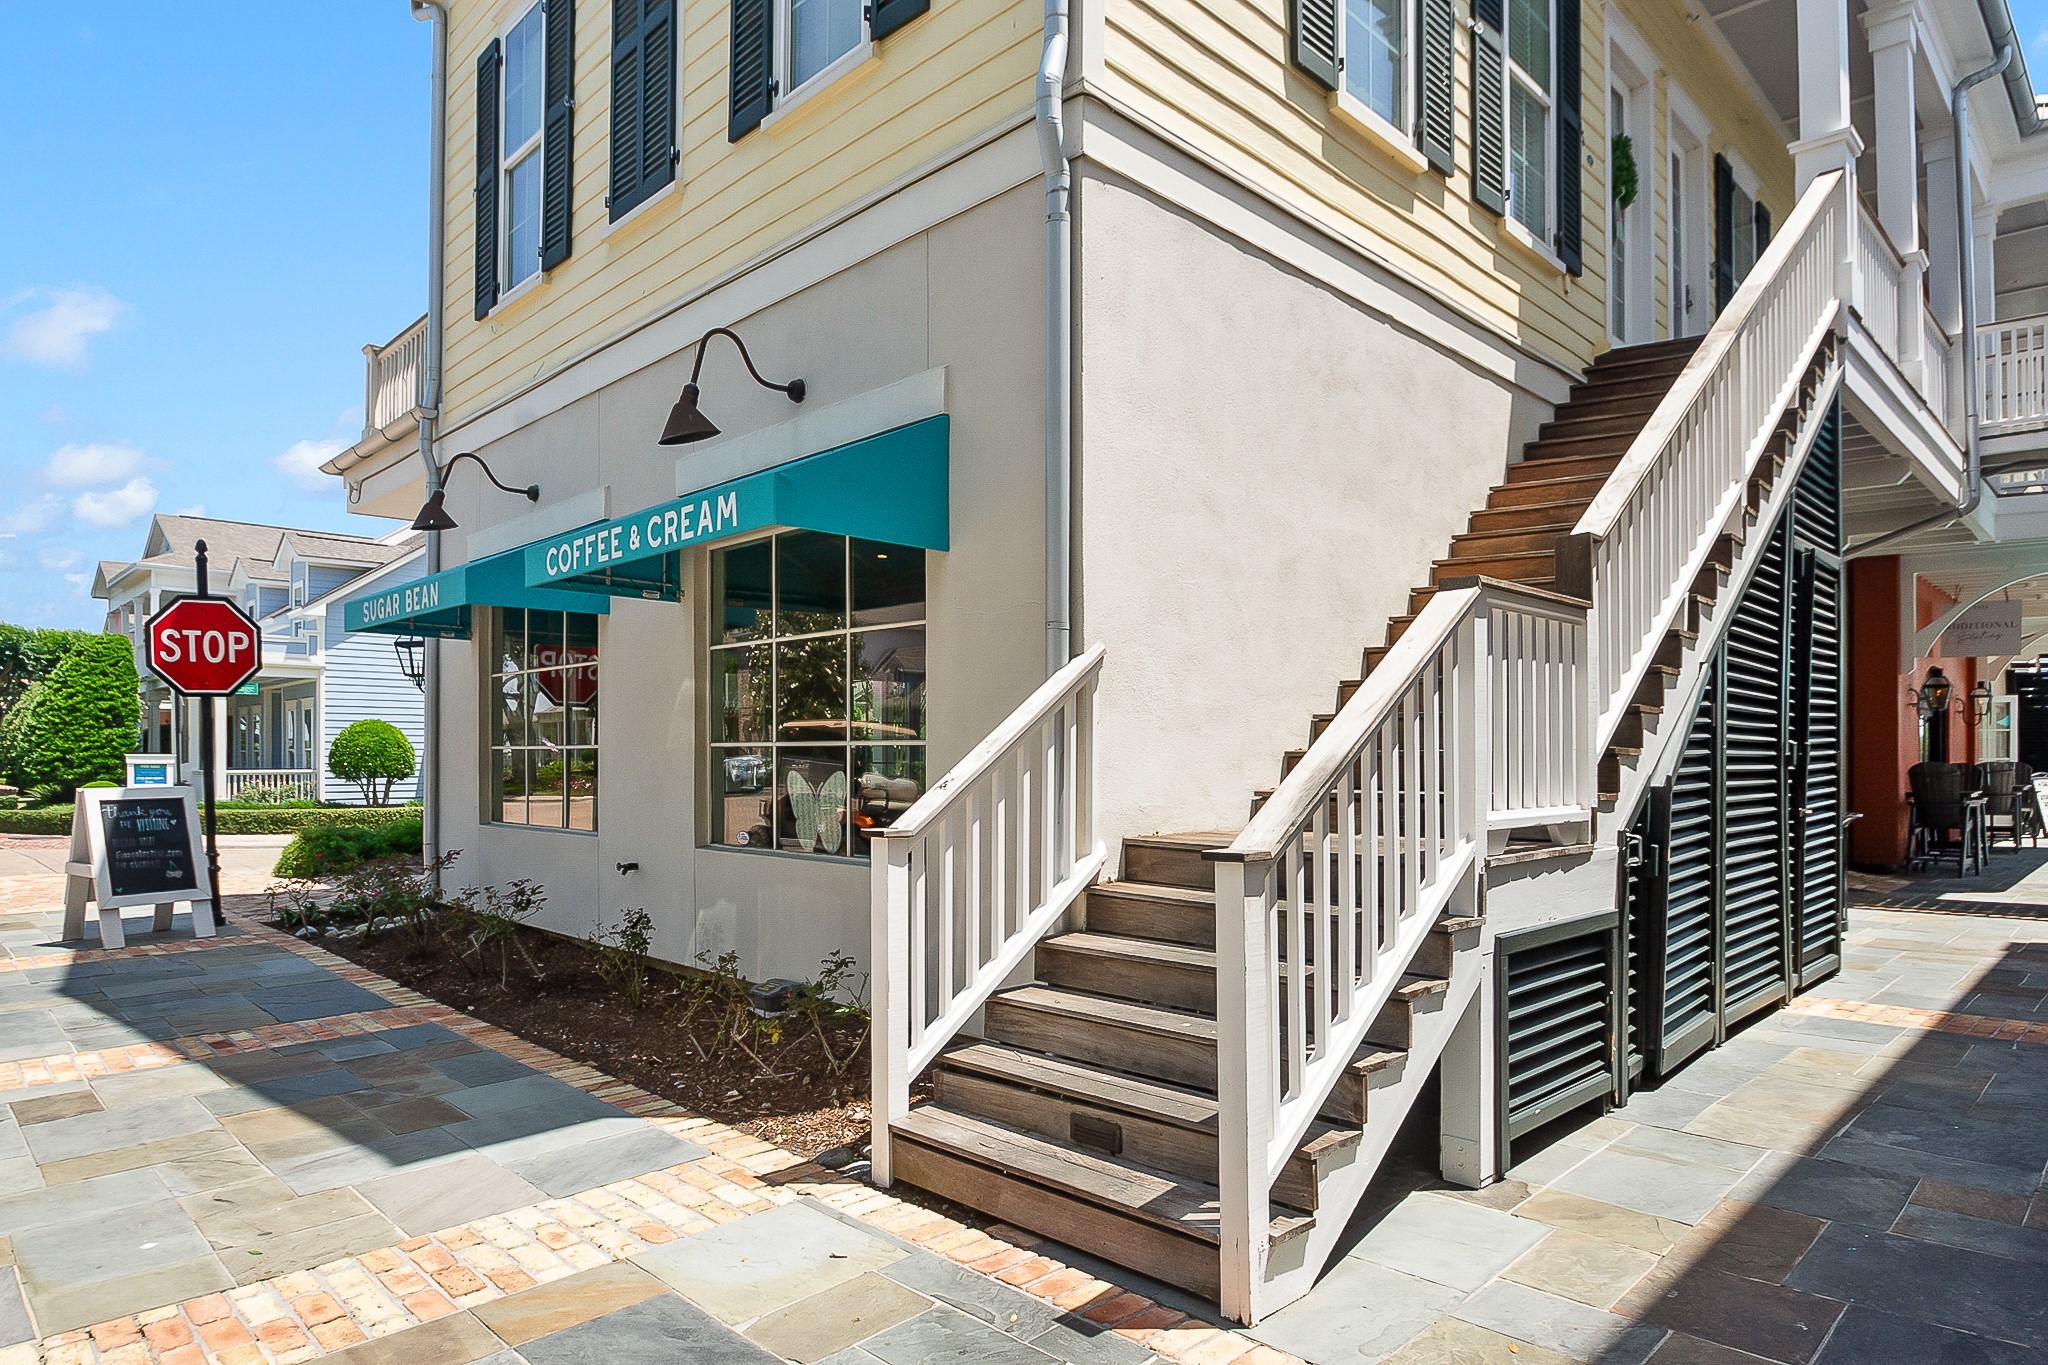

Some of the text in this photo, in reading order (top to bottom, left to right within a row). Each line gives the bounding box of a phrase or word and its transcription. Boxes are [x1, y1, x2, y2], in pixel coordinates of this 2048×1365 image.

[546, 491, 738, 576] COFFEE & CREAM
[363, 581, 439, 623] SUGAR BEAN
[159, 628, 250, 663] STOP
